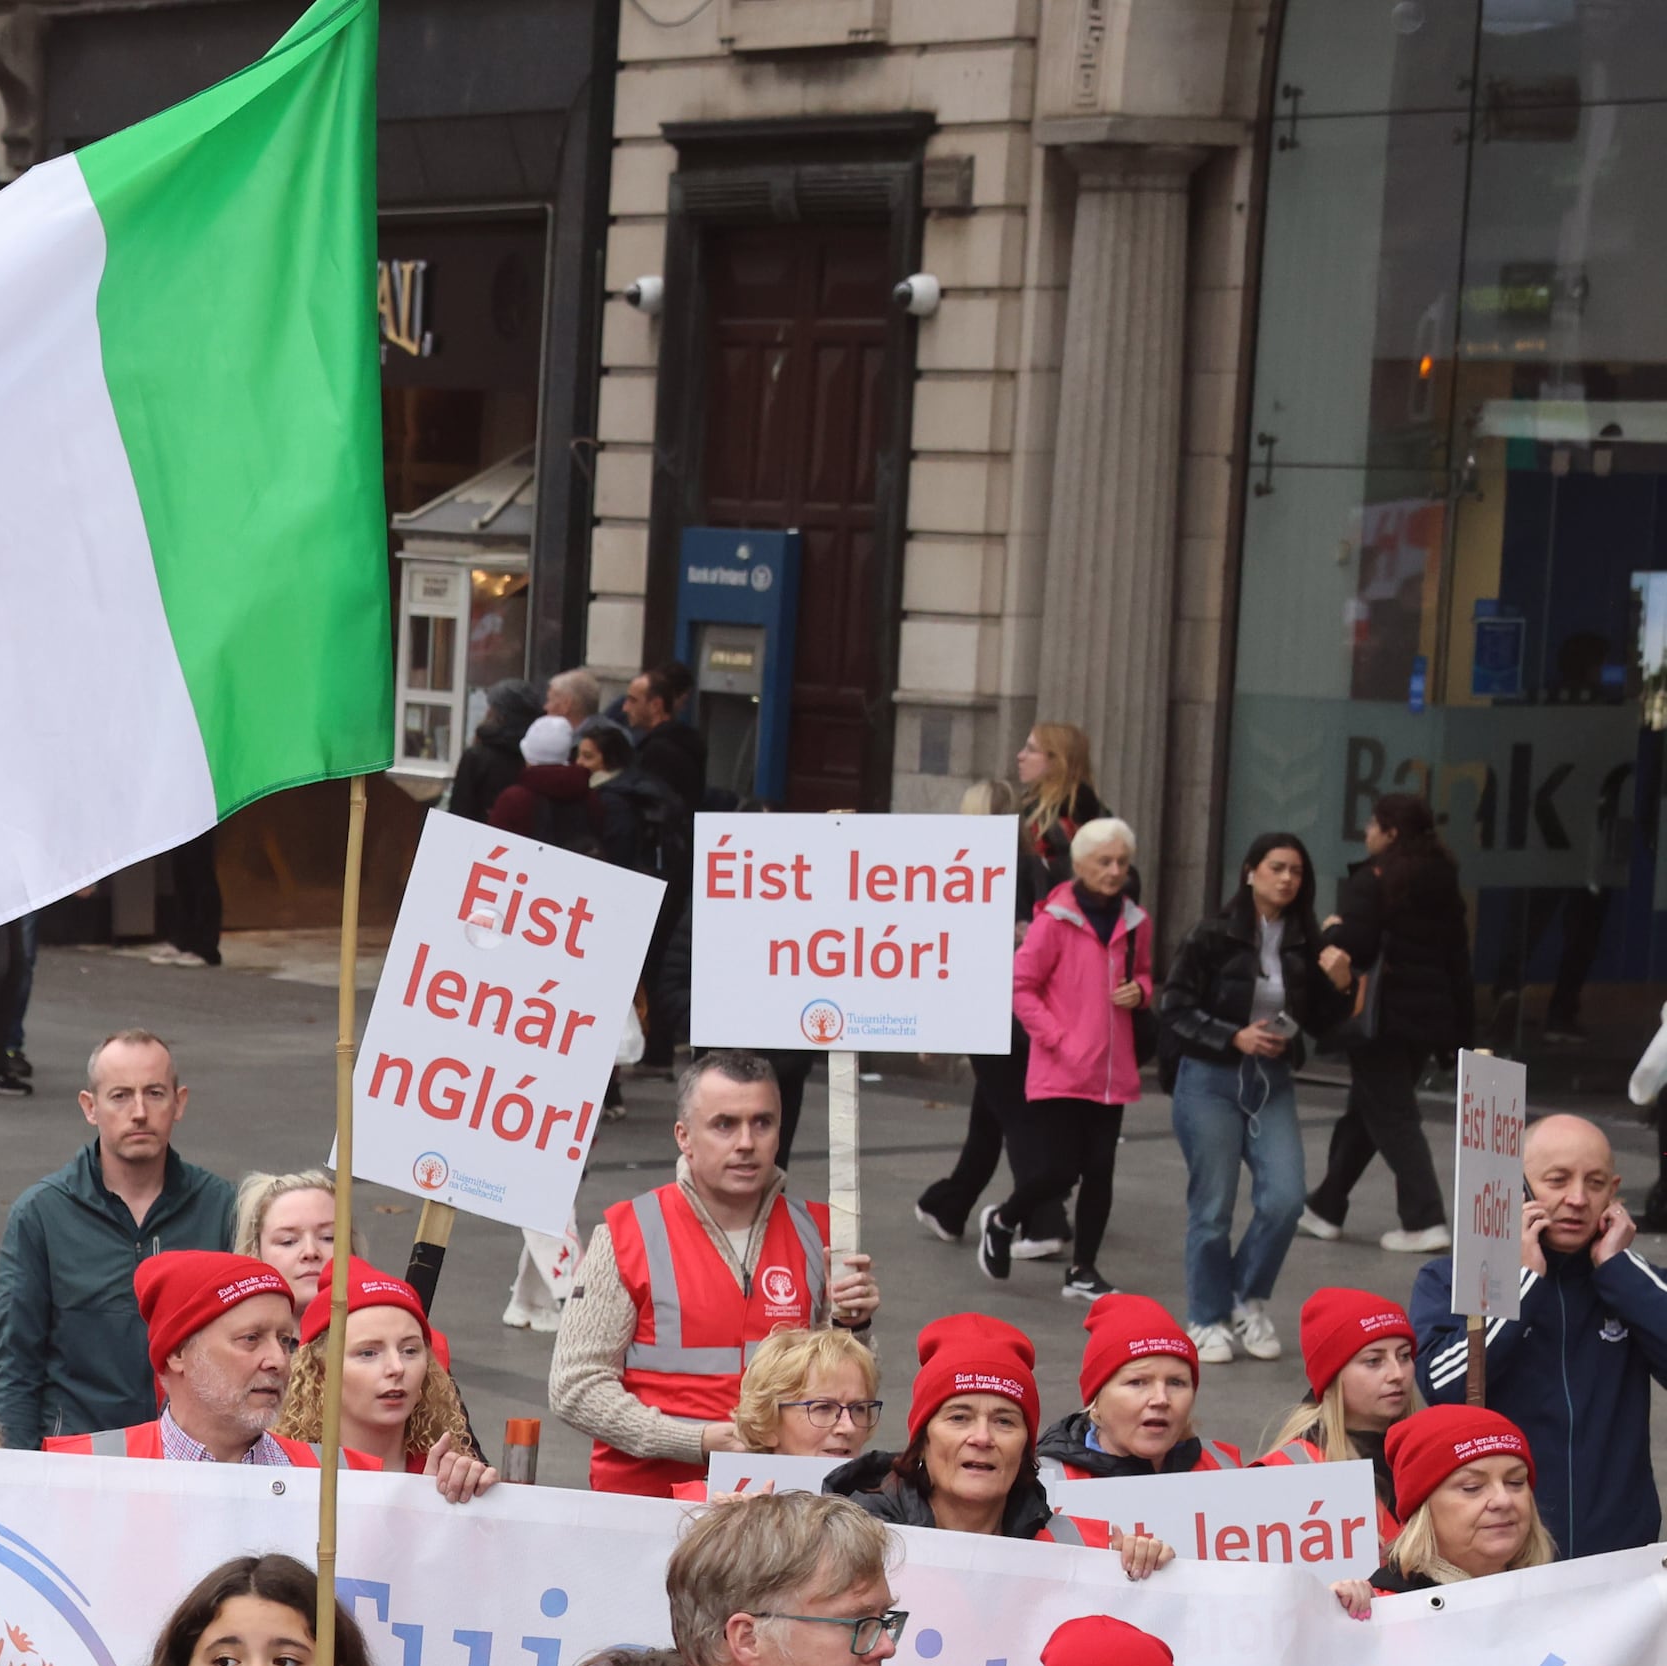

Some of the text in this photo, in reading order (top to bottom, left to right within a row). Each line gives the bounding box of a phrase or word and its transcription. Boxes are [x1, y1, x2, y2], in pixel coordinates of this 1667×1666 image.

[457, 845, 594, 959] Éist
[706, 834, 1007, 904] Éist lenár
[769, 924, 949, 980] nGlór!
[401, 943, 596, 1056] lenár
[368, 1051, 594, 1161] nGlór!
[1462, 1085, 1524, 1160] Éist lenár
[1473, 1177, 1510, 1240] nGlór!
[955, 1372, 1001, 1384] Éist lenár
[1195, 1500, 1366, 1563] lenár
